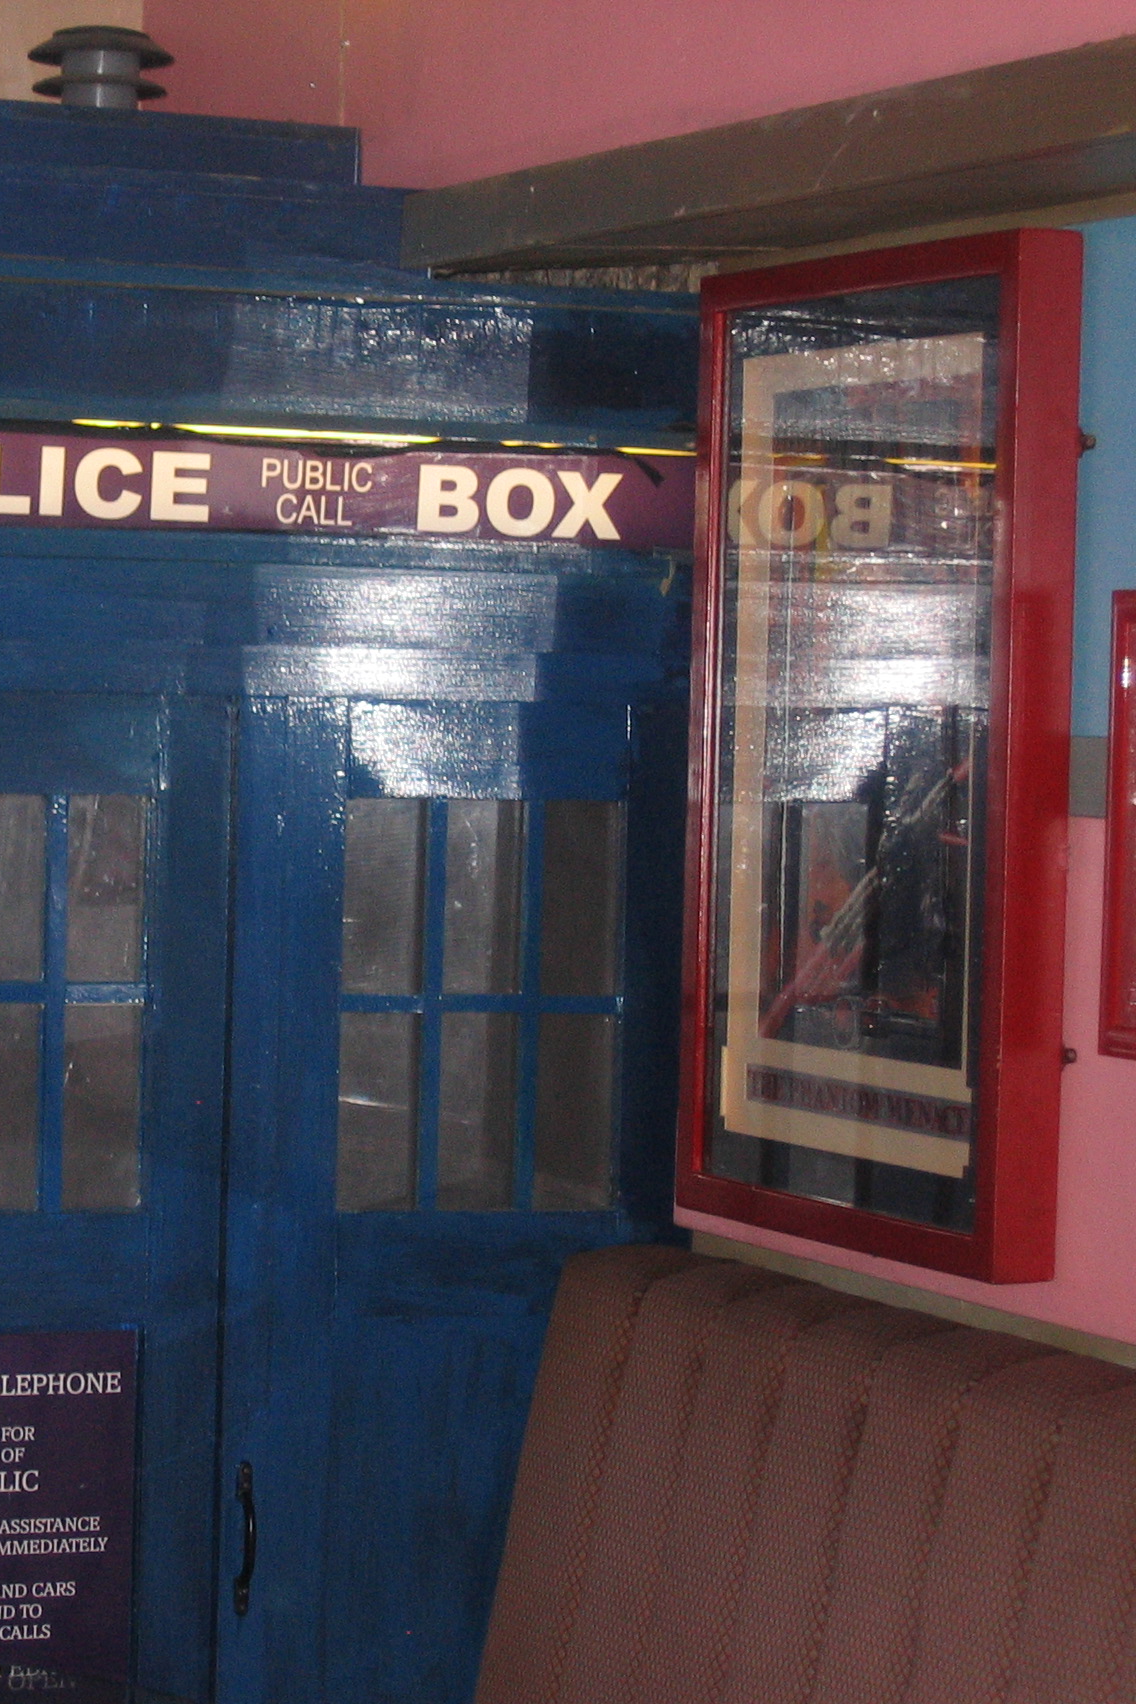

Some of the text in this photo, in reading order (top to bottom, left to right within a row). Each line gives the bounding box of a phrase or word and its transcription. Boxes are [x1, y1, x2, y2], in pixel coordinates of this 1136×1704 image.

[261, 458, 374, 493] PUBLIC
[276, 492, 353, 527] CALL
[416, 464, 624, 541] BOX
[1, 1426, 35, 1441] FOR
[1, 1447, 26, 1462] OF
[32, 1581, 76, 1597] CARS
[19, 1604, 43, 1619] TO
[0, 1623, 51, 1641] CALLS
